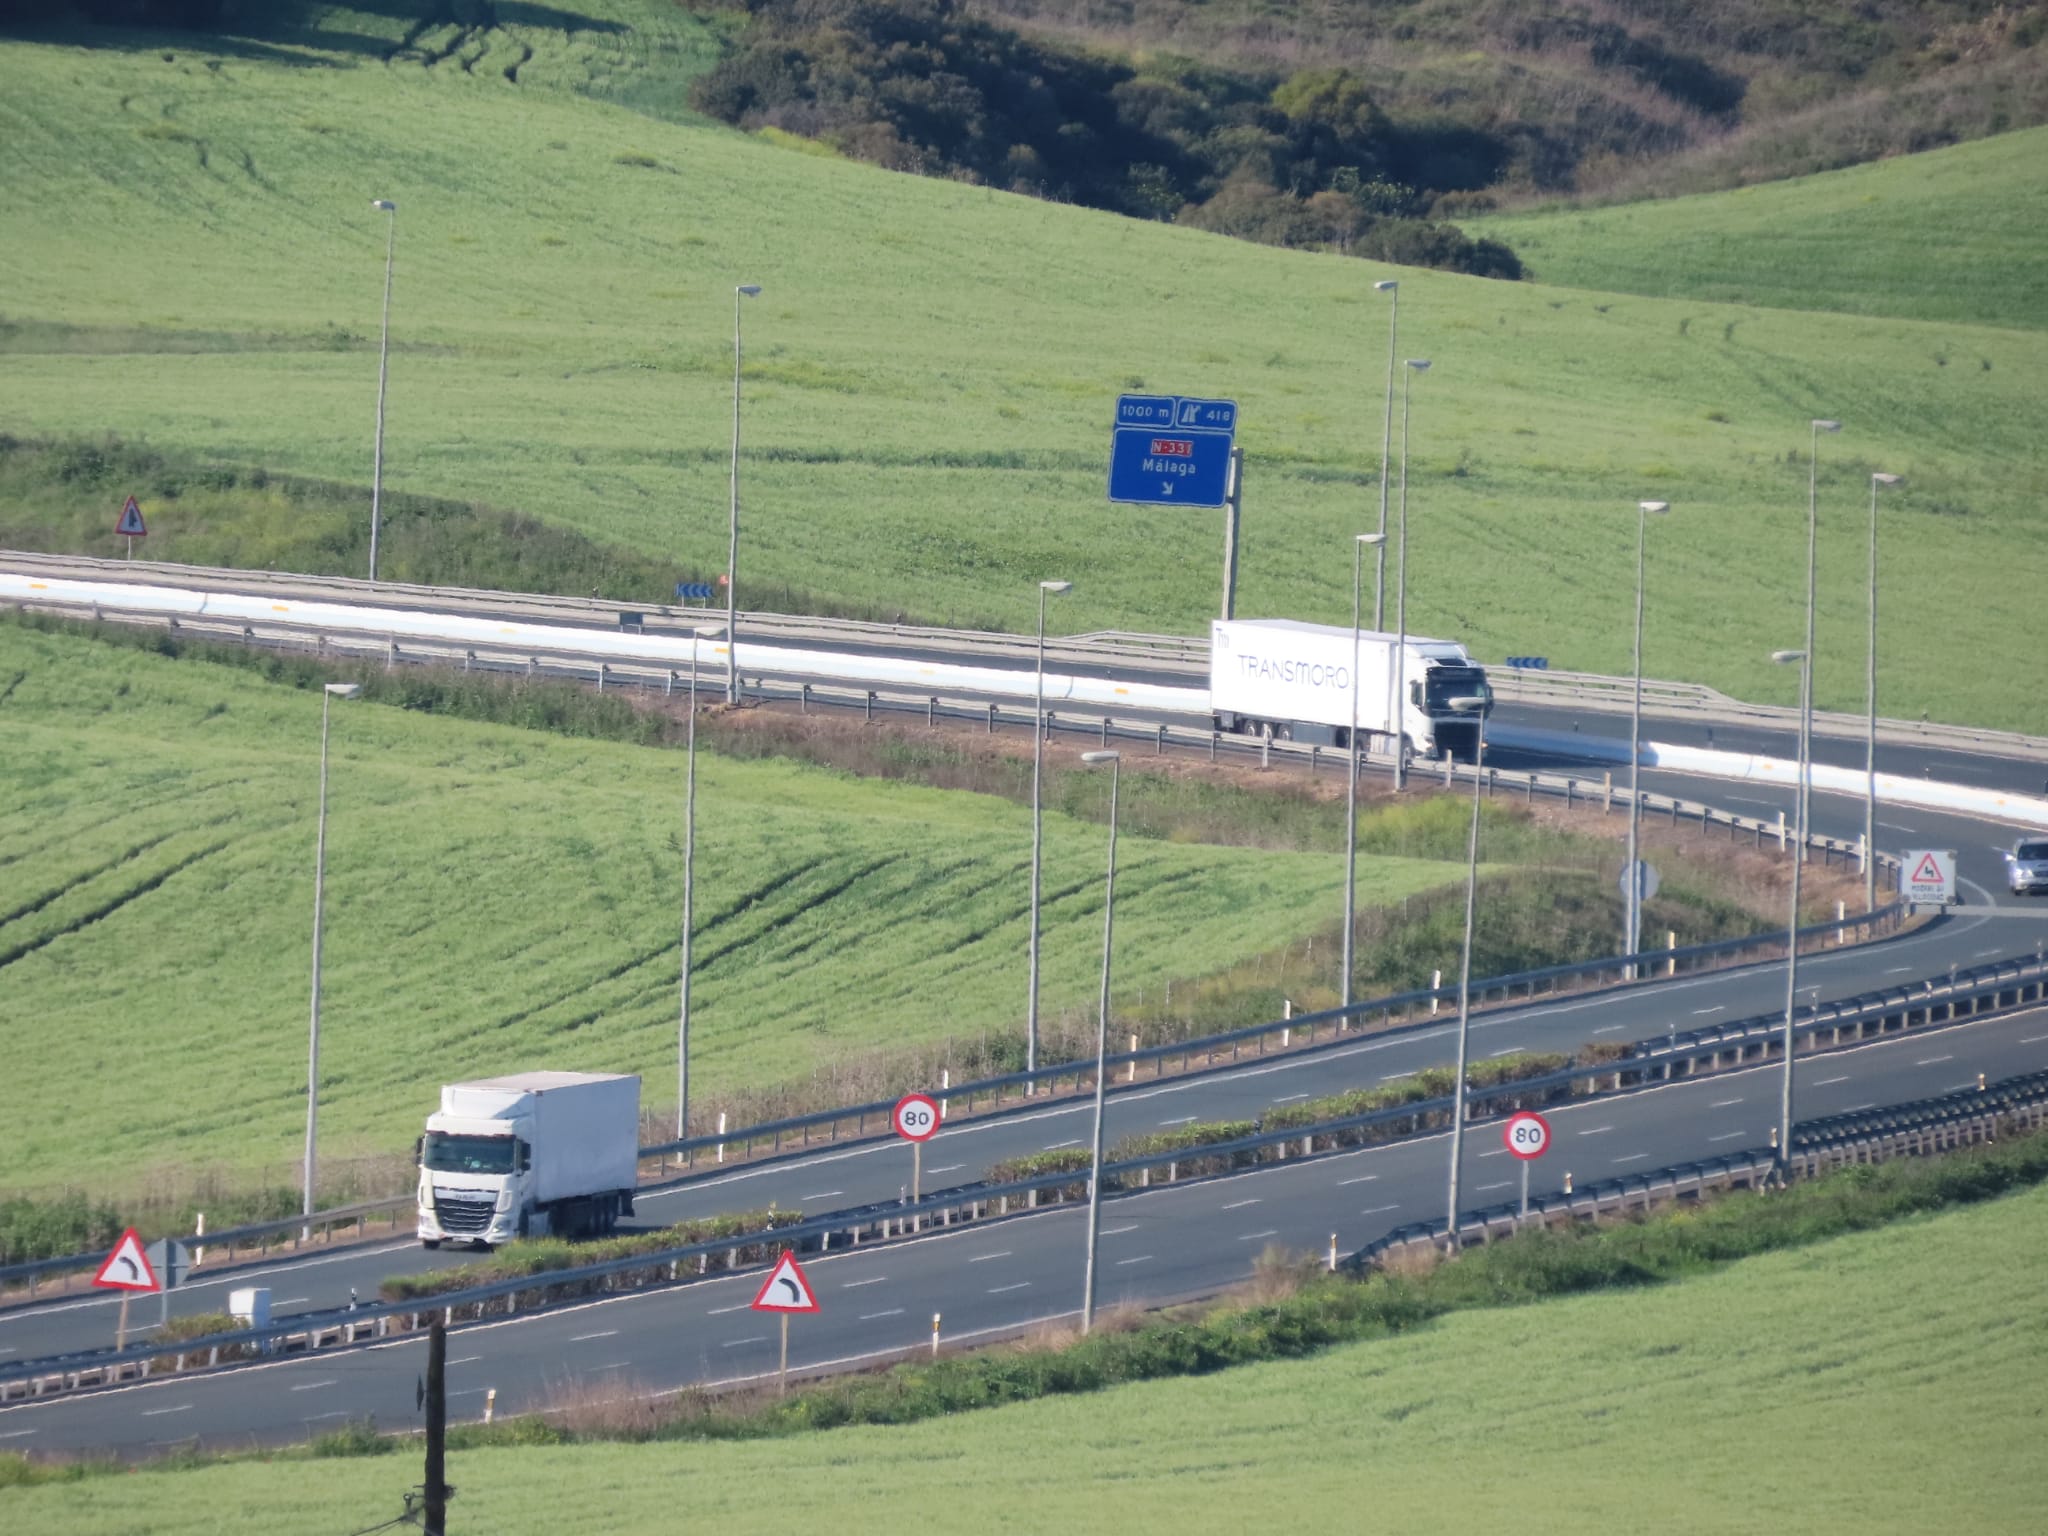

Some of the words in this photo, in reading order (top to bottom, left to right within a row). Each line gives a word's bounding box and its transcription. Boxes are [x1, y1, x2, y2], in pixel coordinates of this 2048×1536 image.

[1122, 405, 1152, 417] 1000
[1158, 410, 1169, 418] m
[1206, 410, 1230, 421] 418
[1153, 441, 1192, 455] N-331
[1142, 458, 1196, 476] Málaga
[1237, 654, 1349, 689] TRANSMORO
[905, 1111, 929, 1126] 80
[1516, 1127, 1541, 1143] 80
